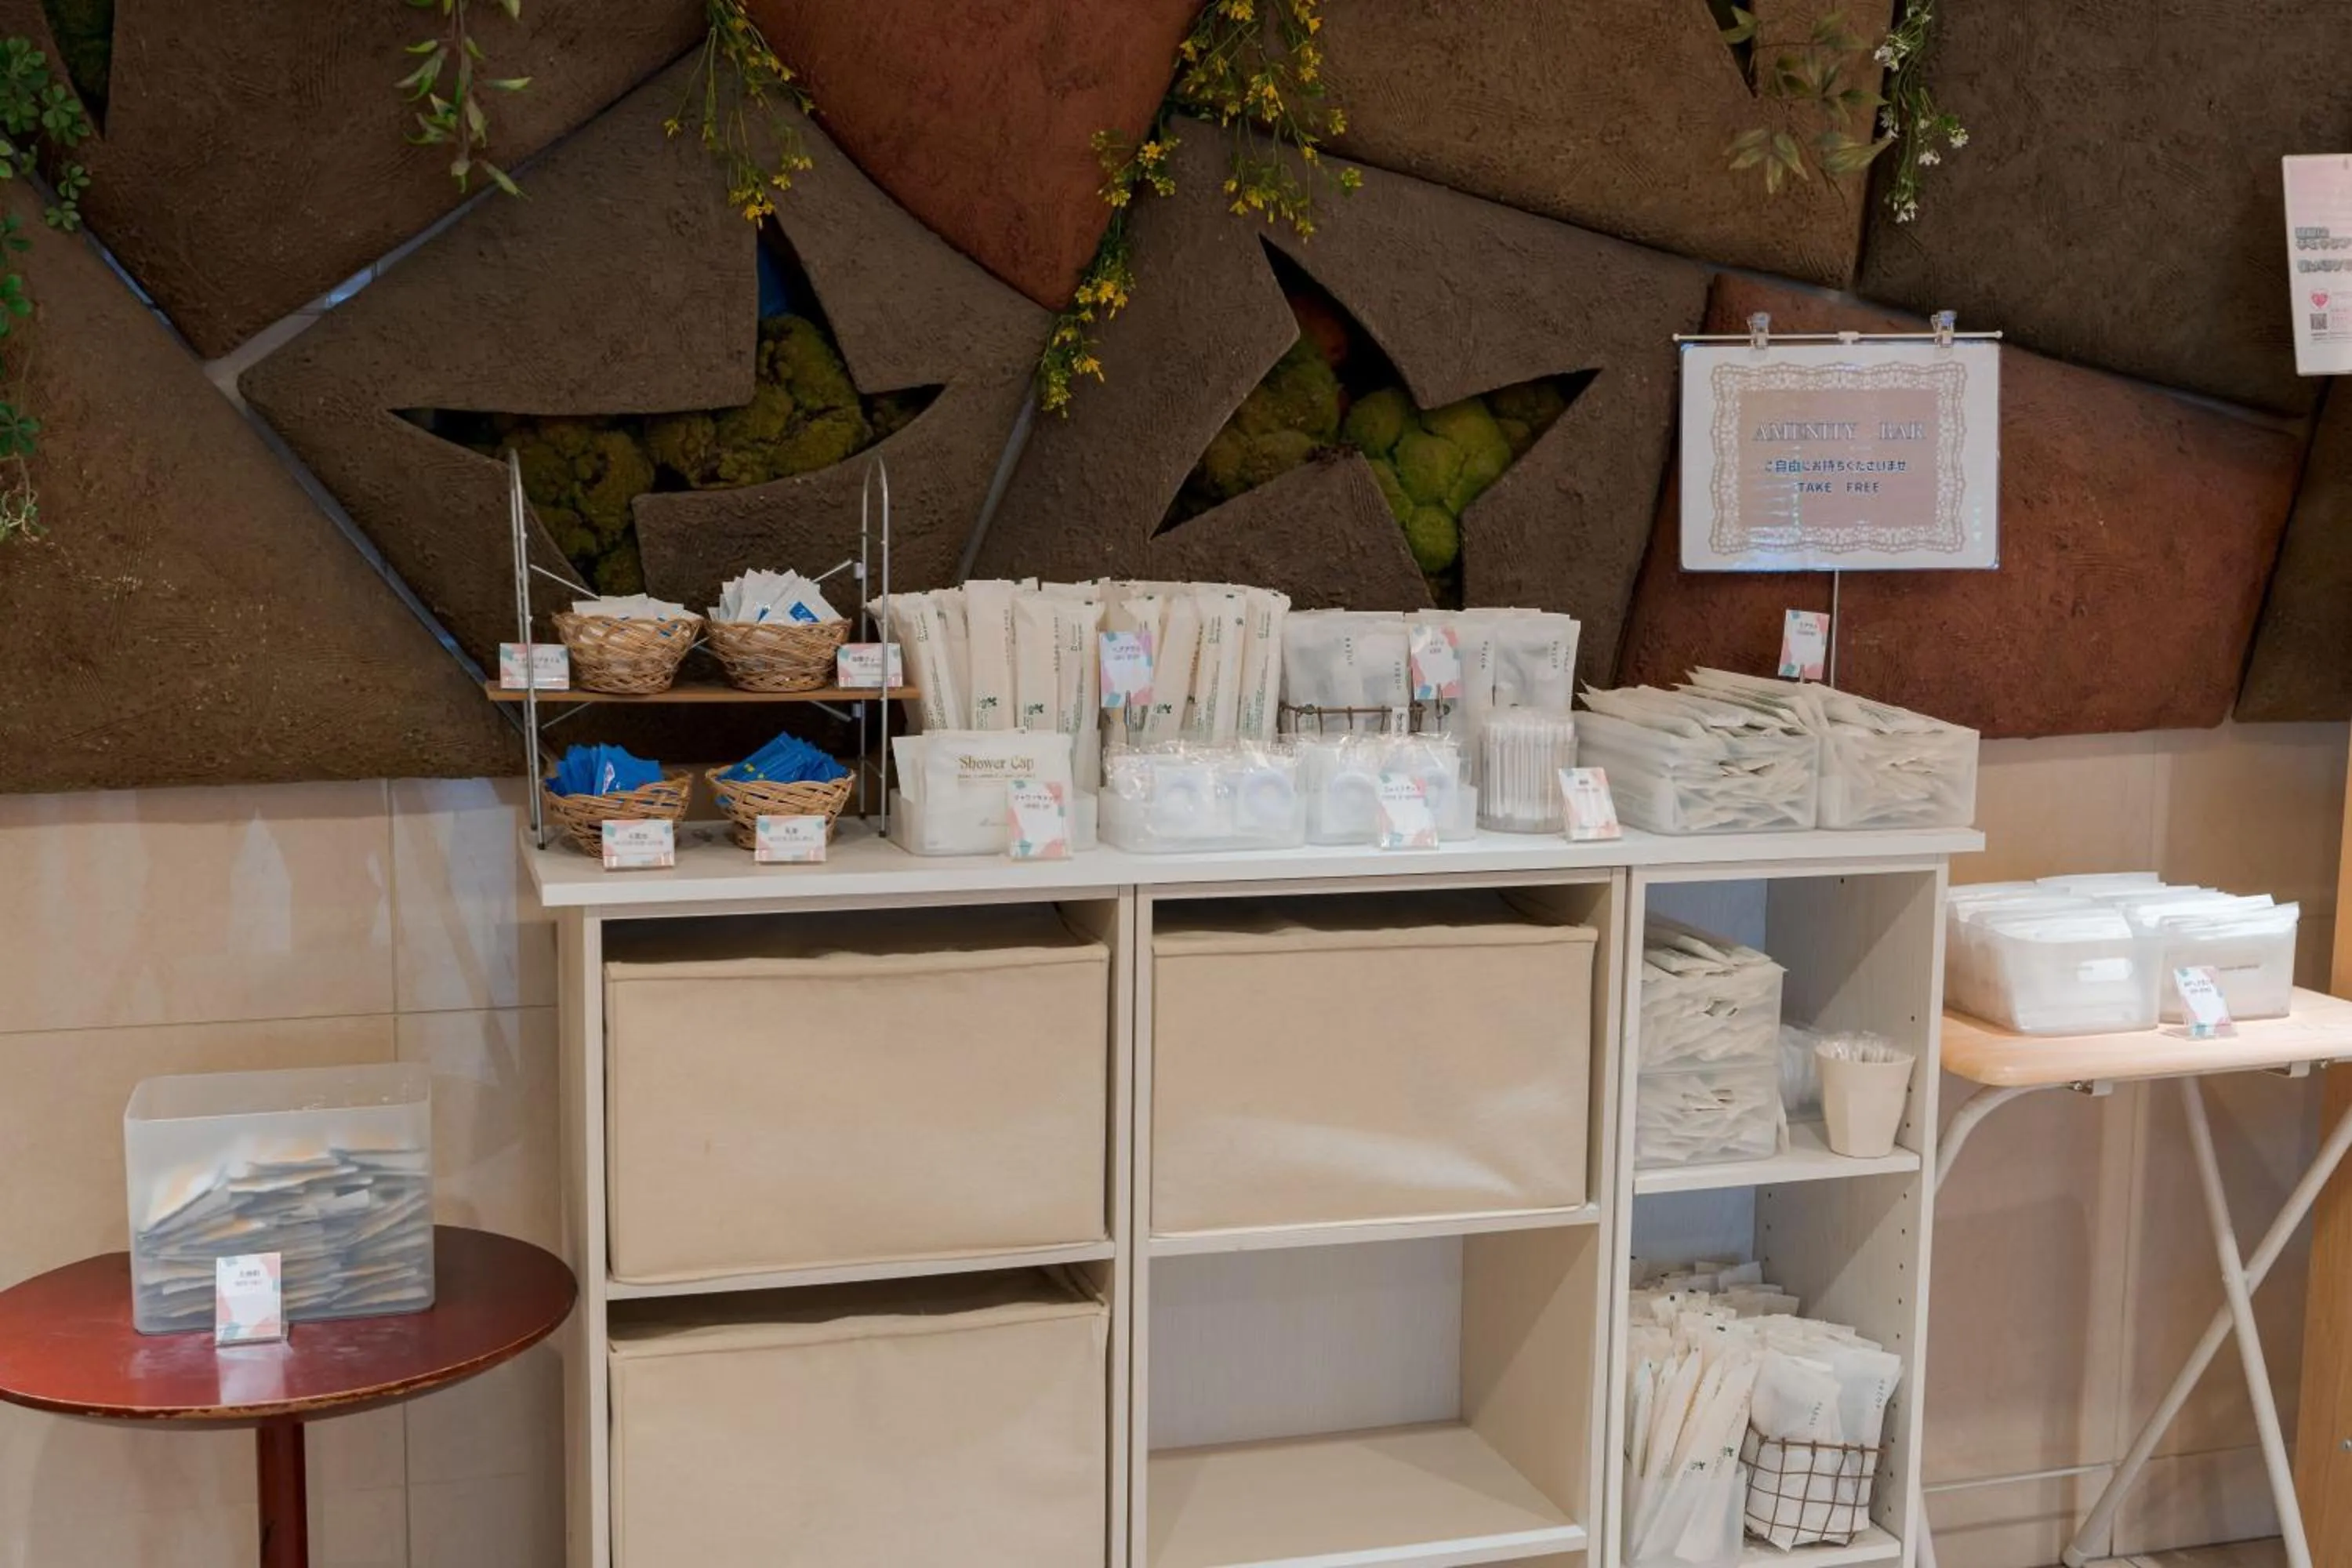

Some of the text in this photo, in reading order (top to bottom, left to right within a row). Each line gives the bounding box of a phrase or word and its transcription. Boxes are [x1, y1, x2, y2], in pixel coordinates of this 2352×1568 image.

[1752, 421, 1927, 441] AMENITY BAR
[1798, 482, 1879, 493] TAKE FREE
[959, 754, 1034, 771] Shower Cap
